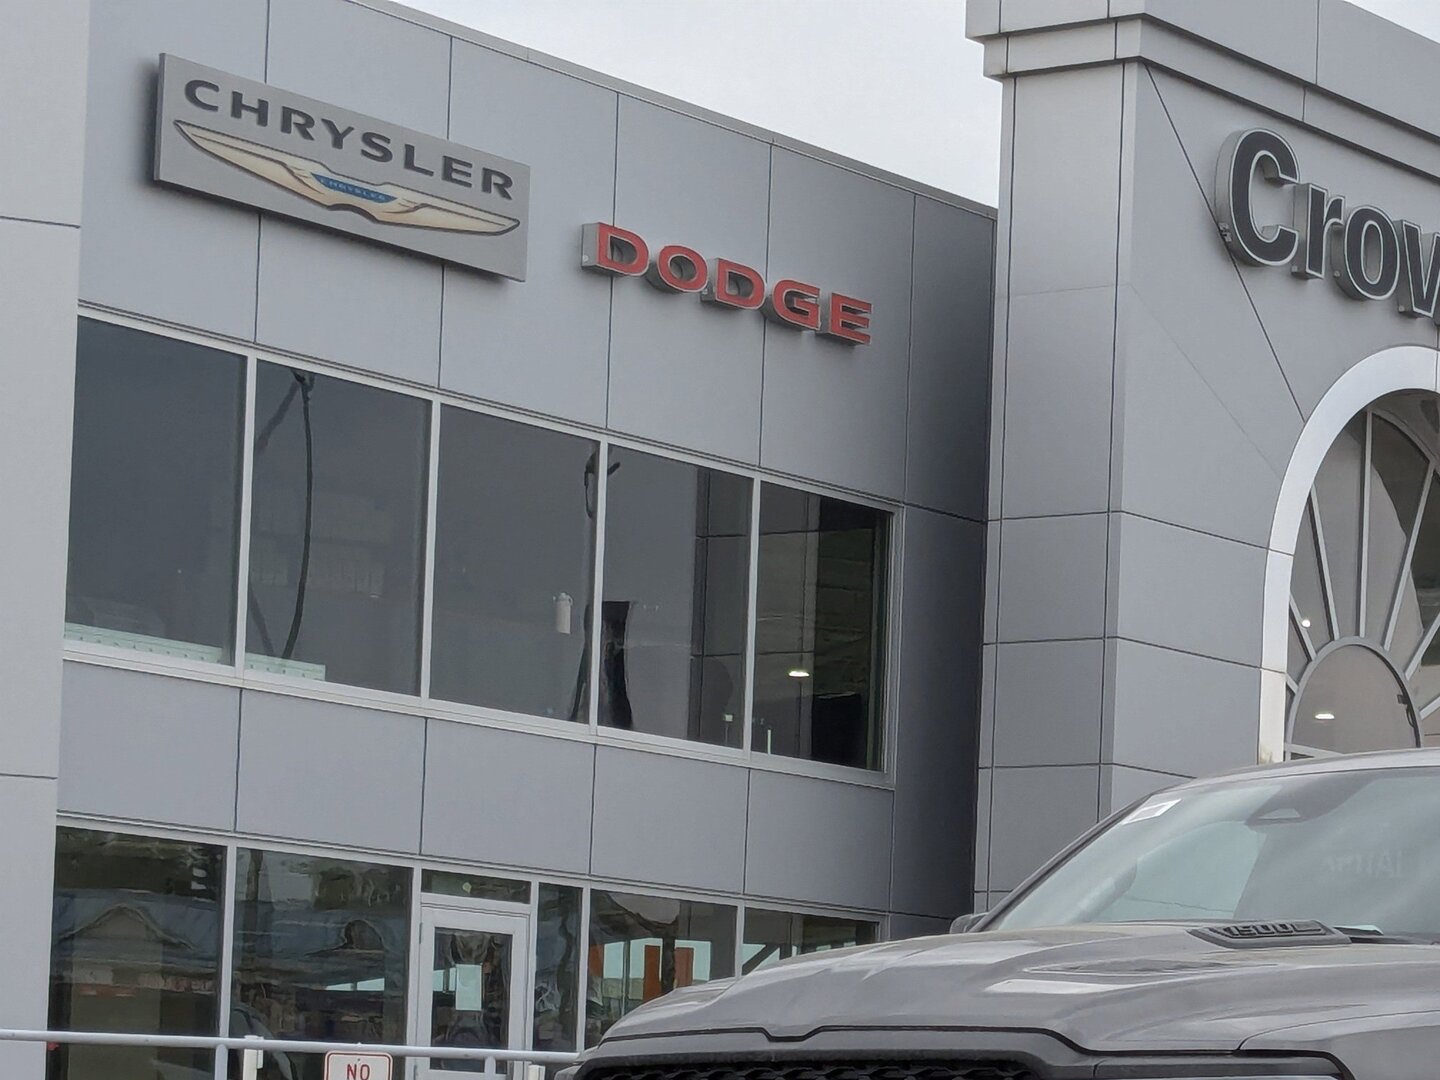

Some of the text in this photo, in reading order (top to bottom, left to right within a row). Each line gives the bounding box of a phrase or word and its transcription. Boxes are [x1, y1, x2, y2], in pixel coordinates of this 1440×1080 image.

[184, 79, 514, 200] CHRYSLER
[590, 222, 873, 345] DODGE
[346, 1063, 370, 1080] NO
